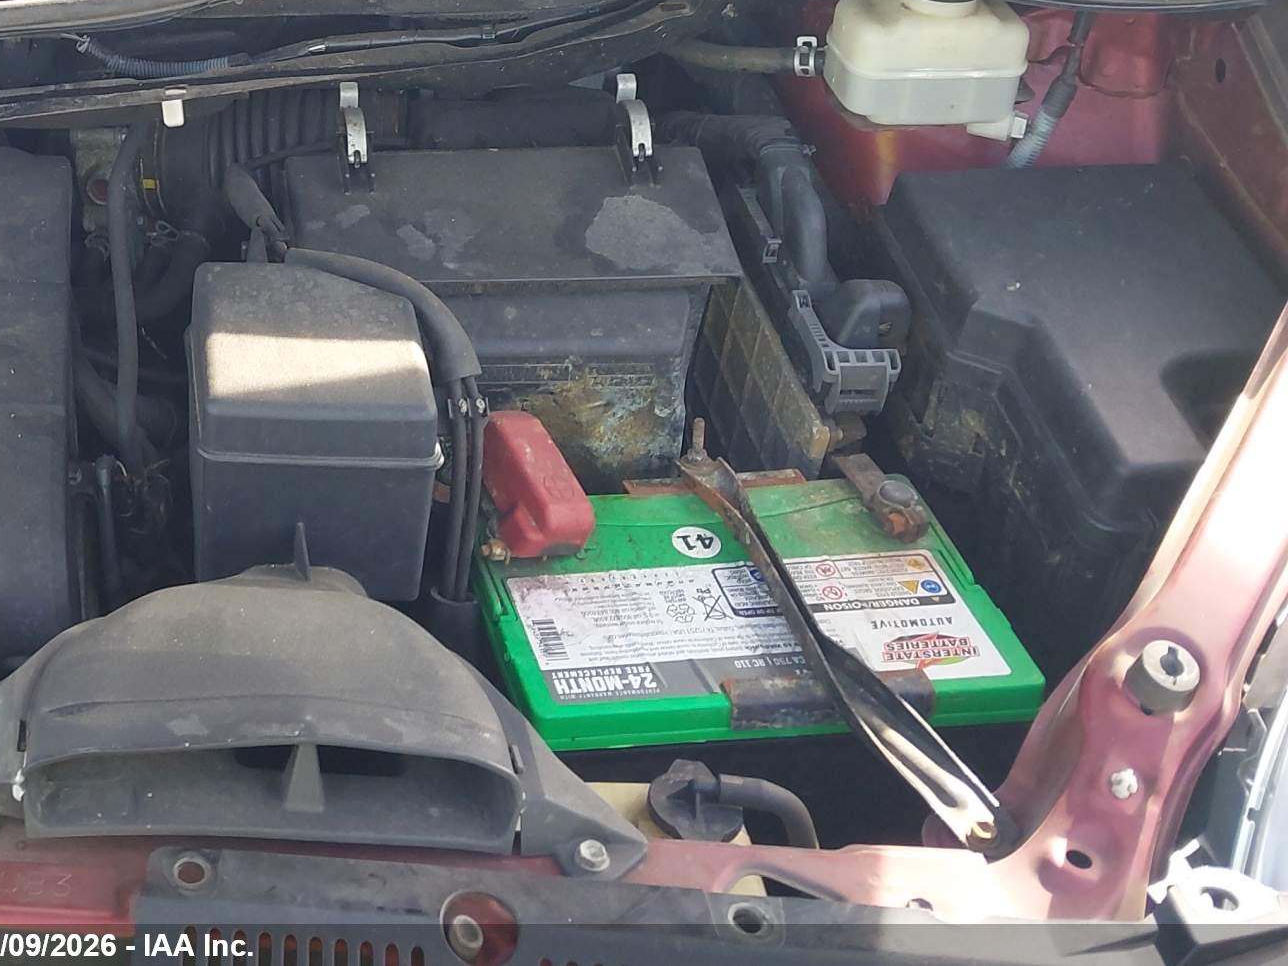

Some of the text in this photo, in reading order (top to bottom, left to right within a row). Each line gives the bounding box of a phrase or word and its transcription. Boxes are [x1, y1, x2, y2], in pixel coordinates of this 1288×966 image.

[676, 534, 714, 551] 41
[871, 616, 952, 630] AUTOMOTIVE
[885, 638, 968, 650] BATTERIES
[885, 646, 978, 661] INTERSTATE
[734, 659, 751, 668] 110
[551, 665, 650, 679] FREE REPLACEMENT
[553, 672, 657, 695] 24-MONTH
